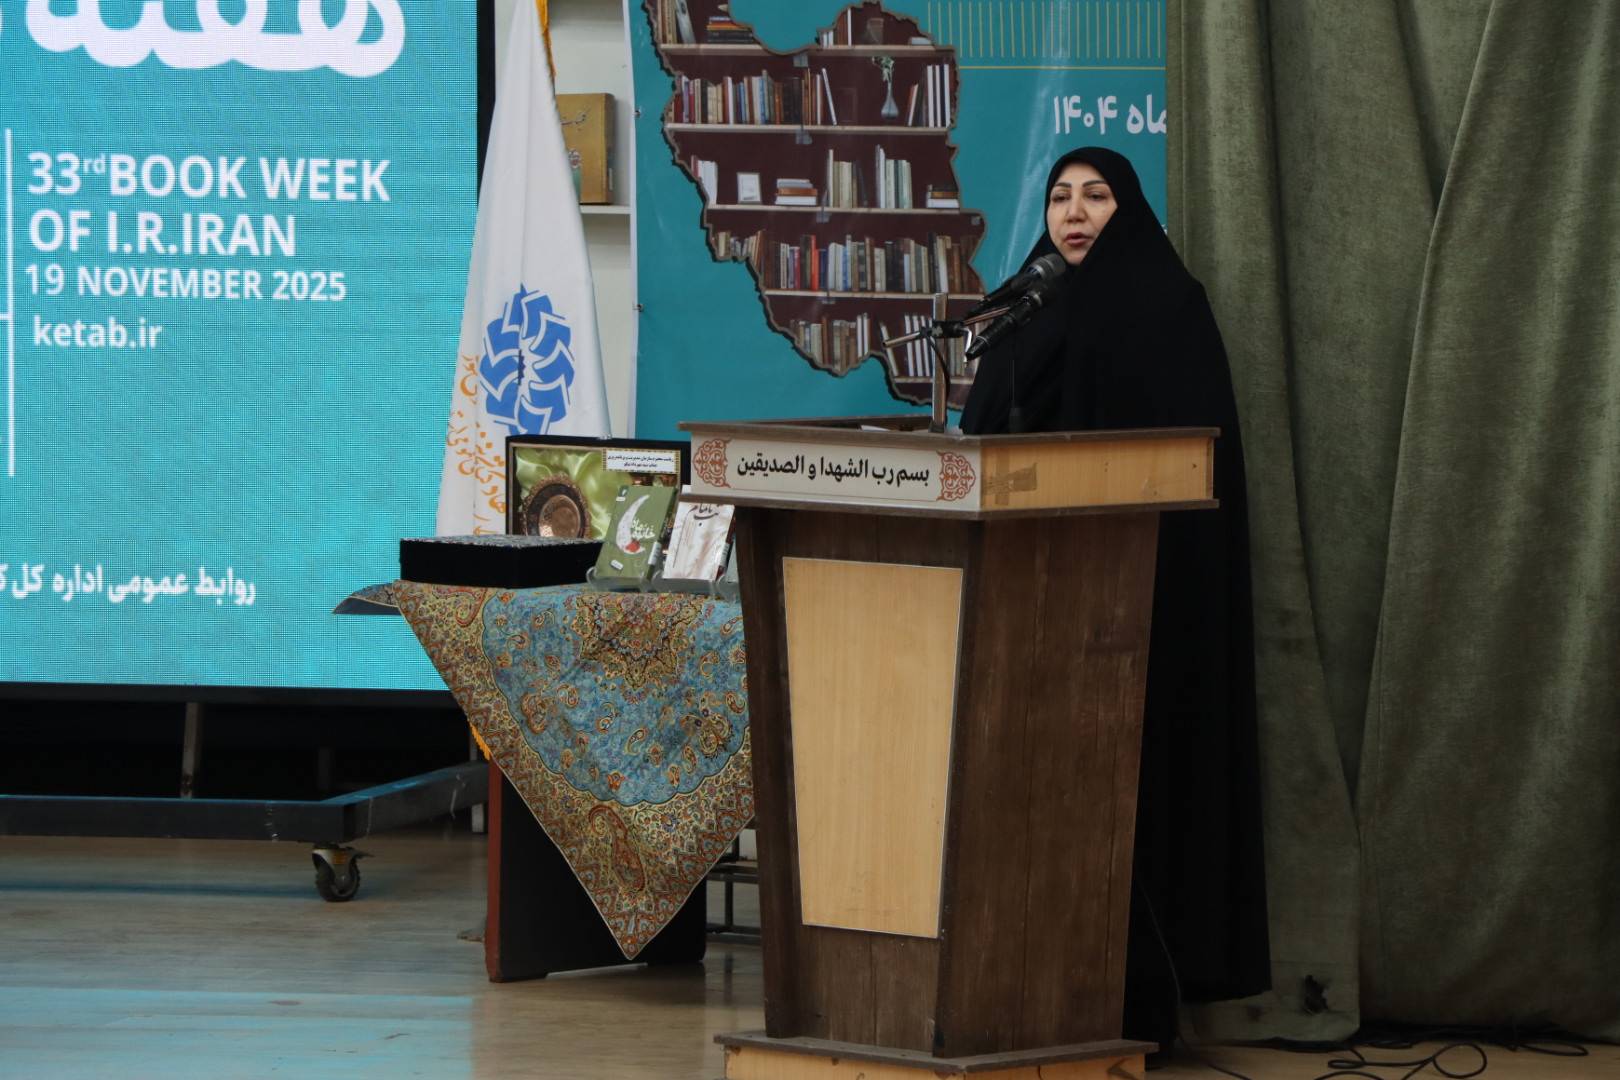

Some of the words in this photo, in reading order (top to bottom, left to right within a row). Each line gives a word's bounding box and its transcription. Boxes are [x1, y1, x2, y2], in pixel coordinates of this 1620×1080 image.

[1053, 95, 1118, 135] ۱۴۰۴
[110, 154, 247, 199] BOOK
[259, 157, 391, 202] WEEK
[29, 208, 91, 252] OF
[107, 211, 296, 257] I.R.IRAN
[25, 264, 65, 295] 19
[77, 266, 263, 299] NOVEMBER
[272, 270, 346, 301] 2025
[33, 315, 163, 348] ketab.ir
[808, 463, 816, 480] و
[820, 457, 869, 482] الشهدا
[871, 466, 894, 485] رب
[896, 469, 930, 487] بسم
[11, 563, 44, 599] کل
[52, 565, 103, 602] اداره
[107, 573, 189, 603] عمومی
[194, 567, 256, 606] روابط
